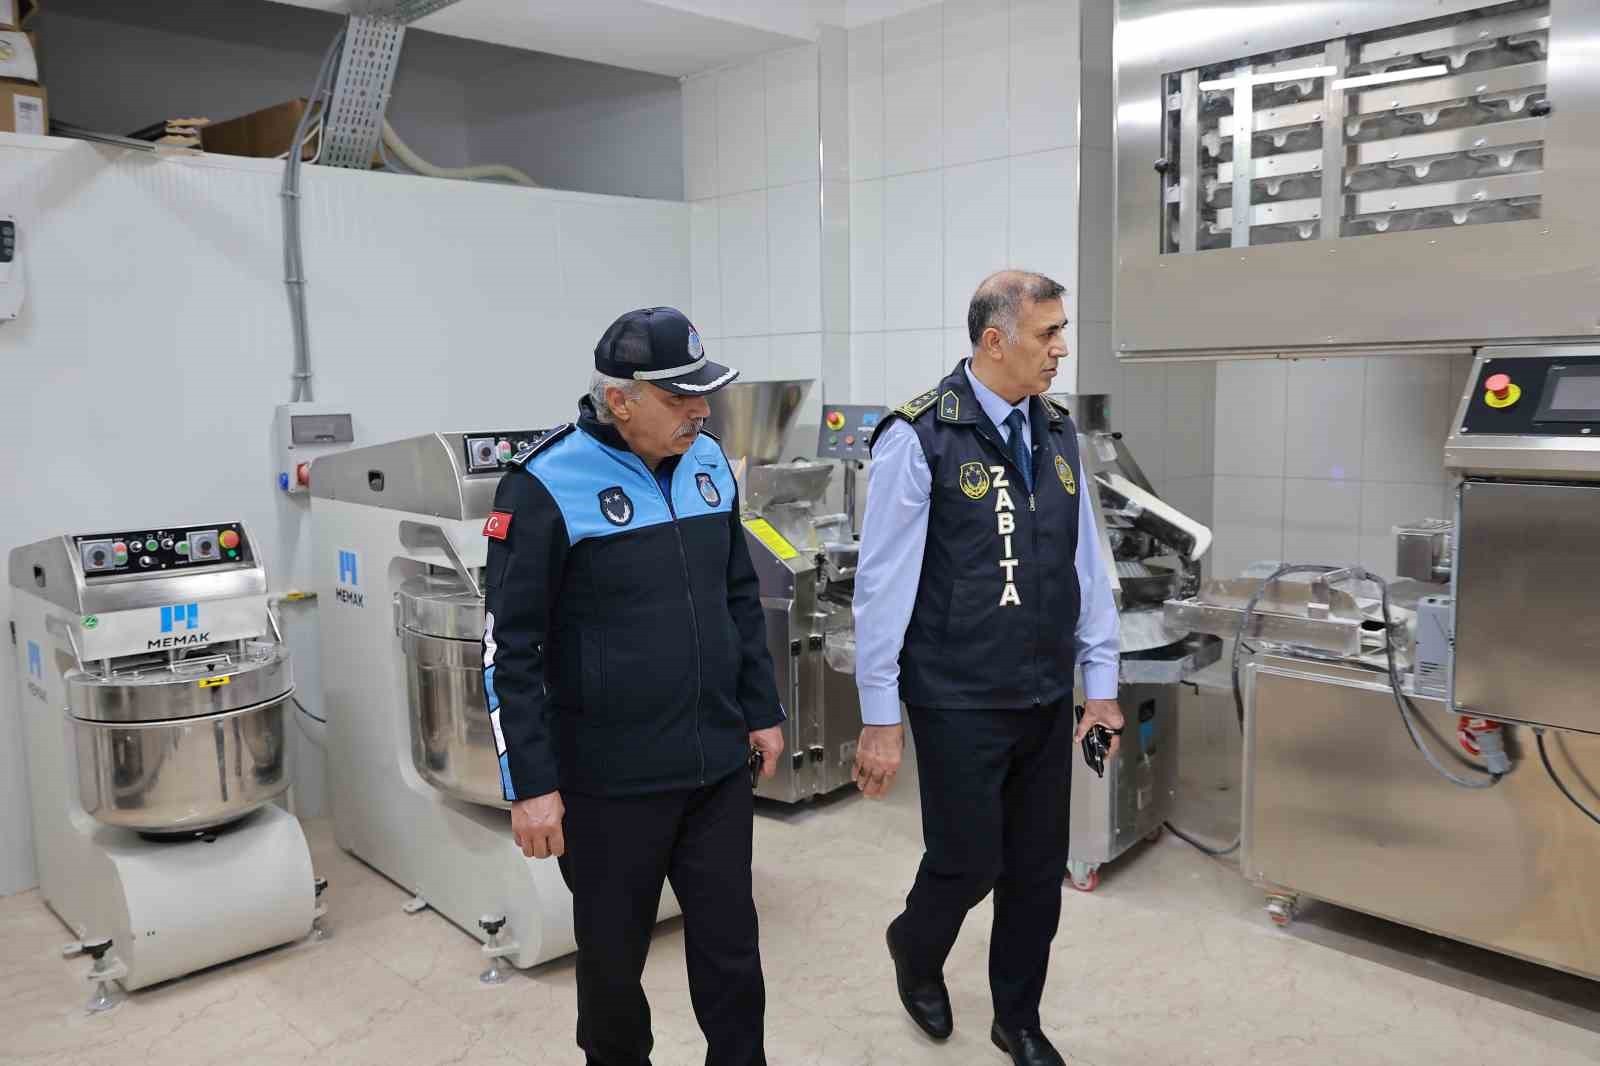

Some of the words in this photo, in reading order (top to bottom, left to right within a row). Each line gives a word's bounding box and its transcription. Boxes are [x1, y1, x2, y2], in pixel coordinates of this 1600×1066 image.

[989, 465, 1021, 606] ZABITA
[336, 586, 364, 608] MEMAK
[147, 631, 210, 649] MEMAK
